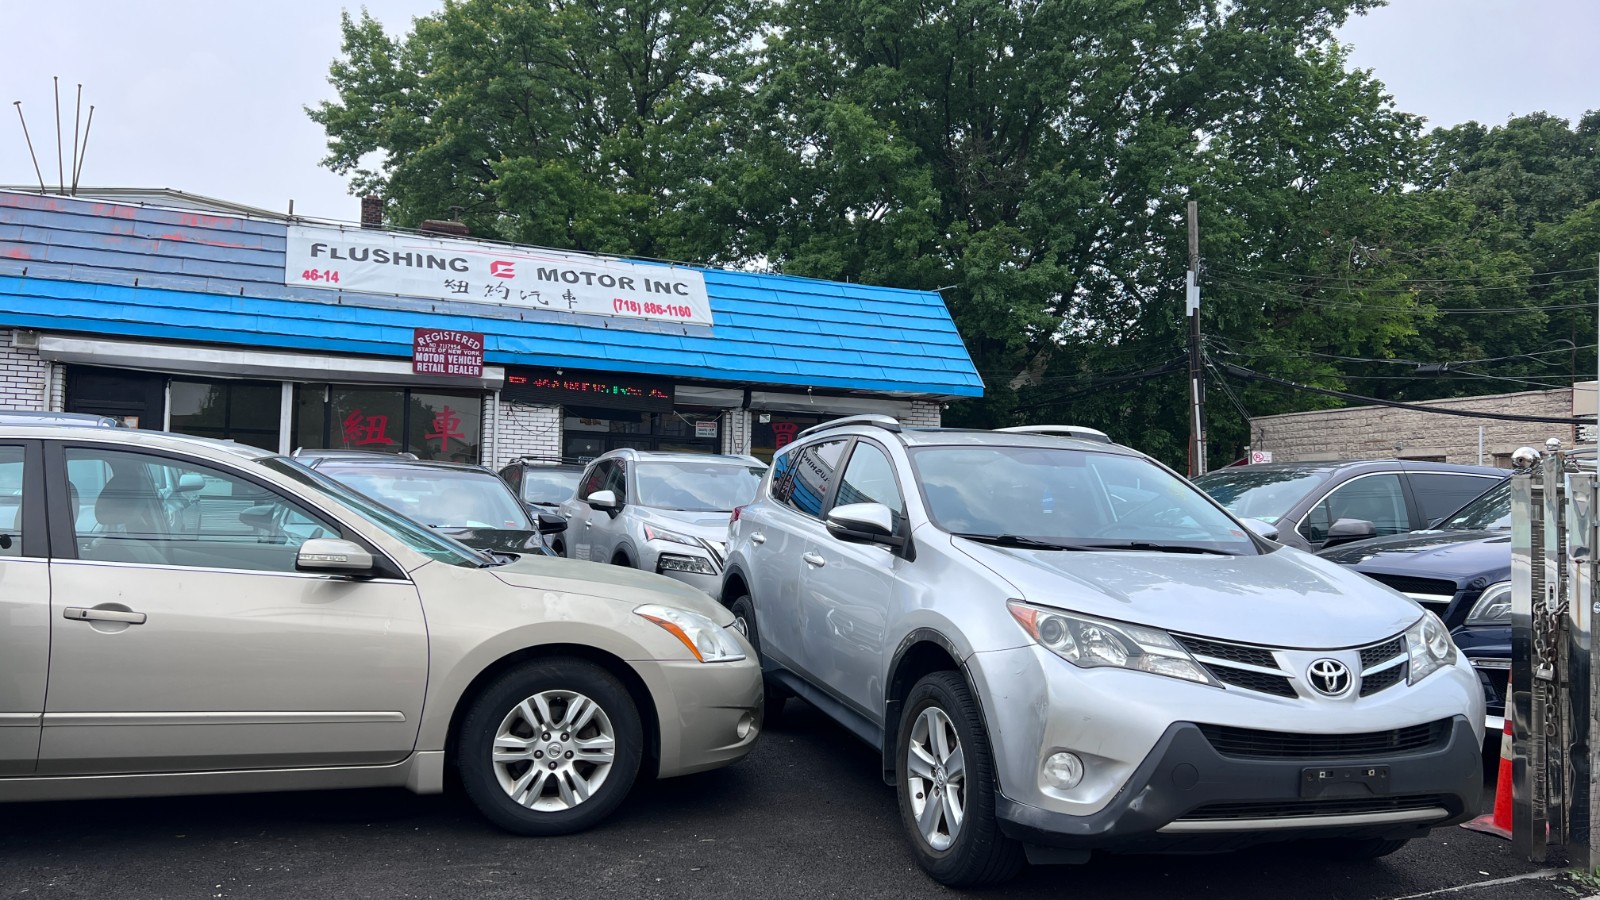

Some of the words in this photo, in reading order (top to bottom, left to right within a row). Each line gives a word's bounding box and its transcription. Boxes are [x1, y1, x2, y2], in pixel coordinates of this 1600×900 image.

[310, 243, 469, 272] FLUSHING
[302, 269, 340, 284] 46-14
[537, 267, 636, 291] MOTOR
[645, 278, 689, 296] INC
[613, 298, 642, 315] (718)
[417, 331, 481, 350] REGISTERED
[415, 352, 445, 363] MOTOR
[448, 354, 482, 366] VEHICLE
[416, 362, 446, 373] RETAIL
[448, 364, 479, 375] DEALER
[424, 405, 465, 453] 車
